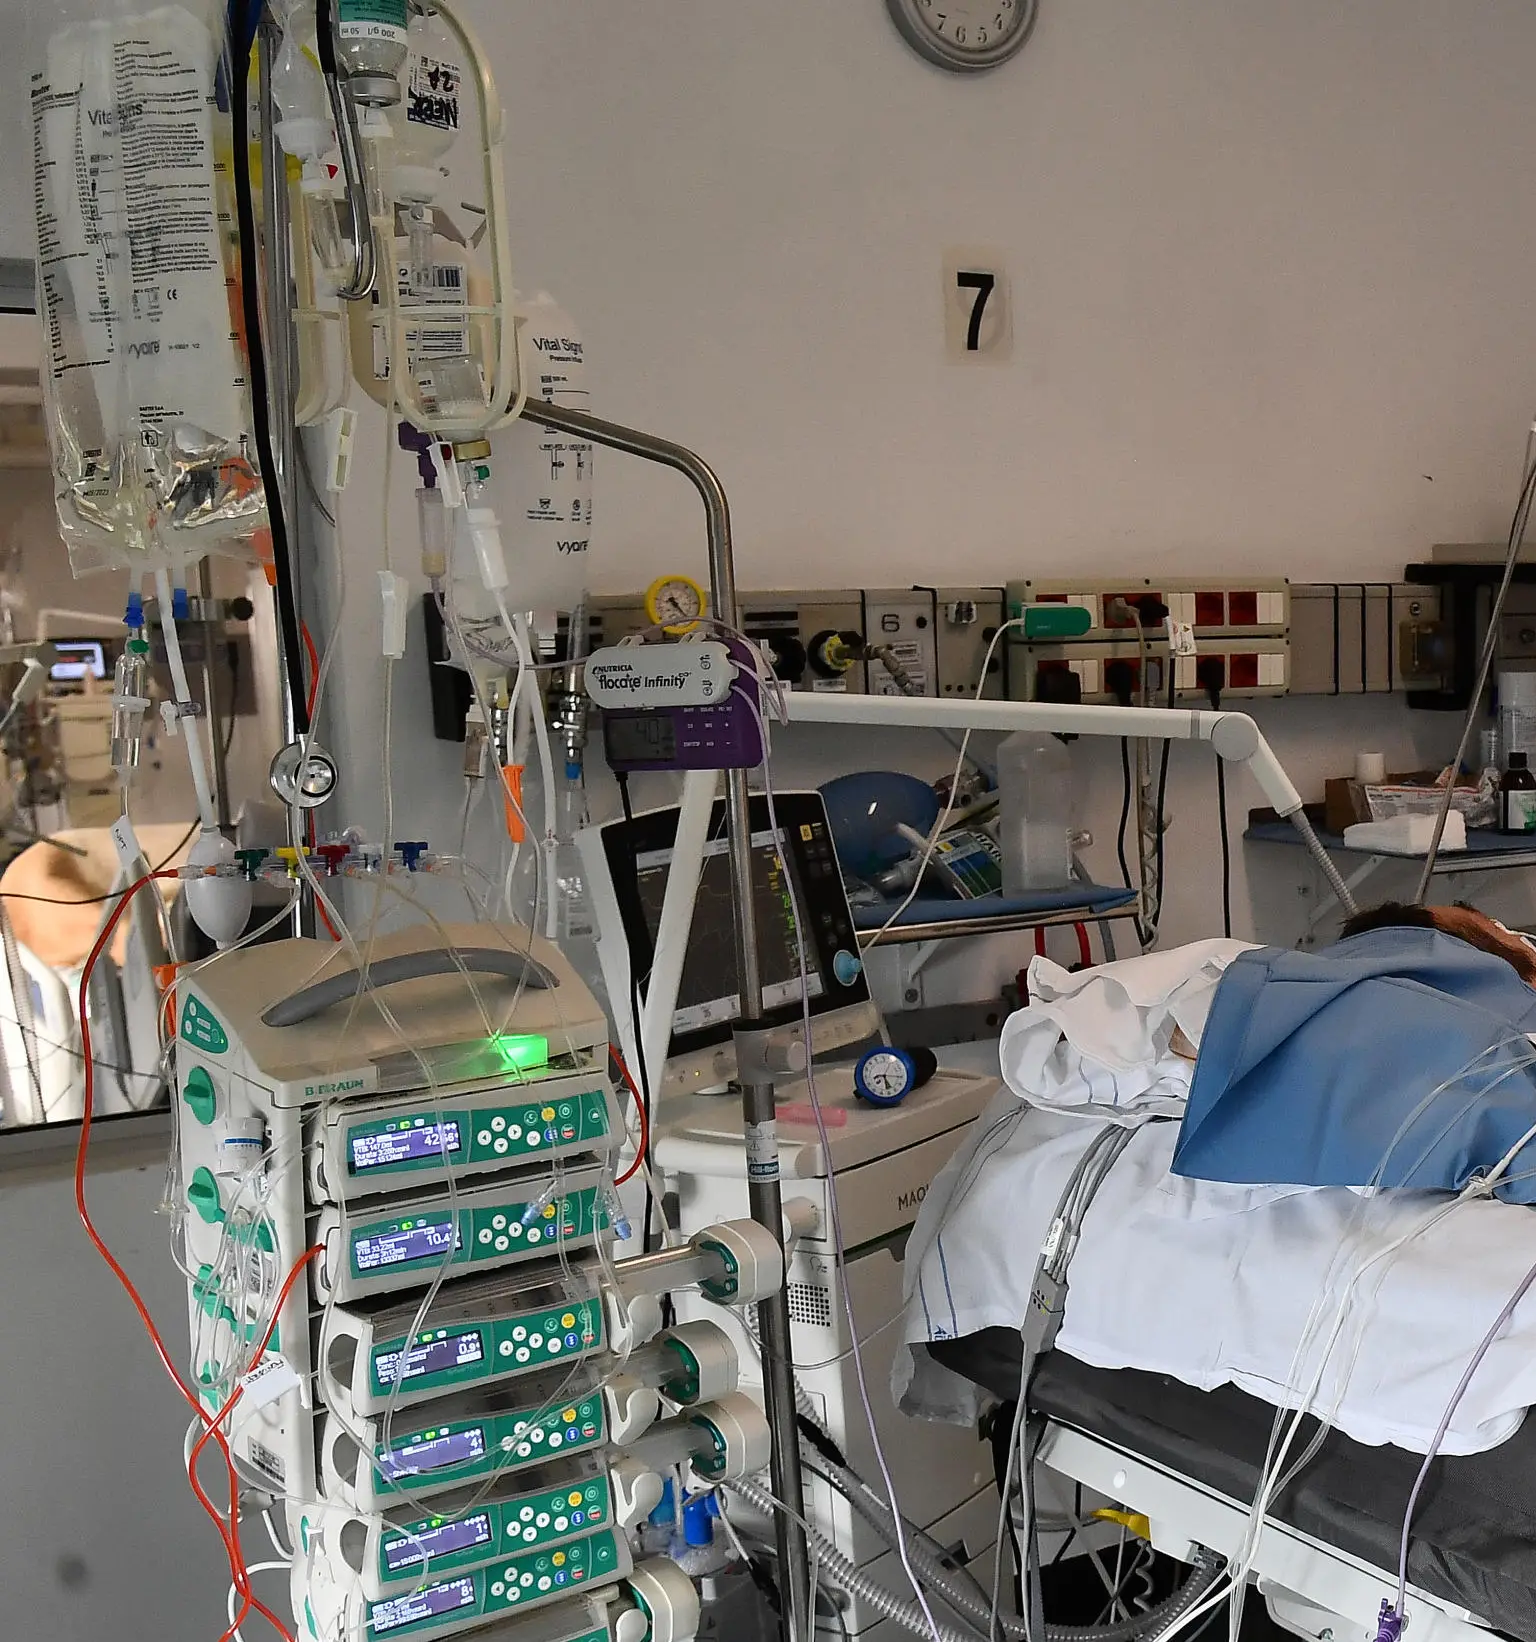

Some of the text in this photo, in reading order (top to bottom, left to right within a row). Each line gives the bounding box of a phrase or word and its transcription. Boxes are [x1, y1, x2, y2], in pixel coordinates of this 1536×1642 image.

[350, 27, 359, 35] 50
[382, 30, 395, 39] 200
[956, 26, 966, 44] 6
[978, 26, 988, 44] 5
[957, 271, 994, 350] 7
[533, 338, 561, 351] Vital
[882, 614, 900, 632] 6
[598, 664, 633, 674] NUTRICIA
[644, 673, 686, 689] Infinity
